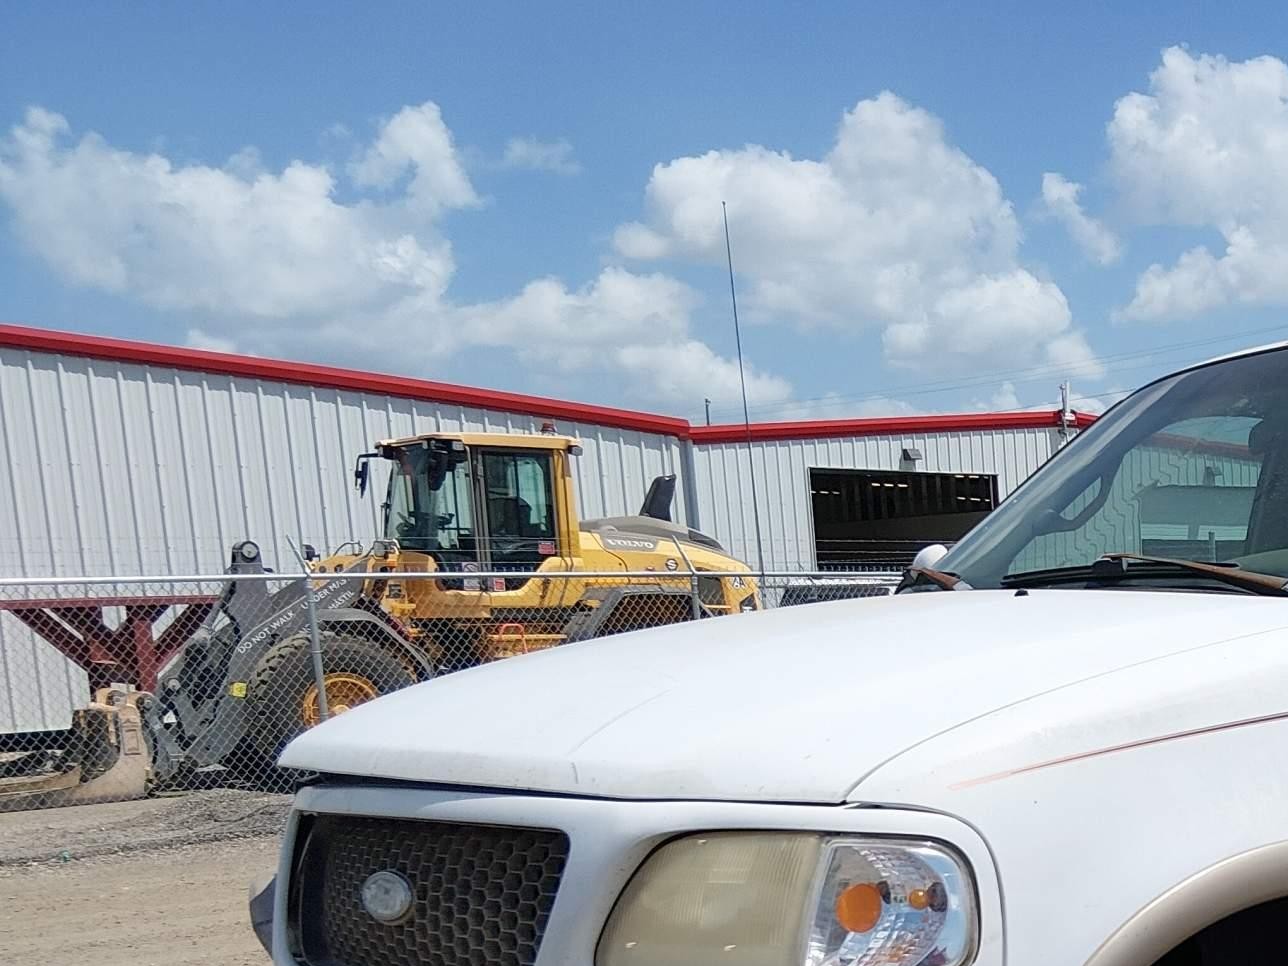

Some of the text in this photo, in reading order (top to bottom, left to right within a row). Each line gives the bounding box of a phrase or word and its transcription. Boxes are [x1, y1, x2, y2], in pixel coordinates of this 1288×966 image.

[606, 539, 654, 549] VOLVO
[238, 641, 252, 653] DO
[251, 627, 271, 643] NOT
[270, 609, 295, 629] WALK
